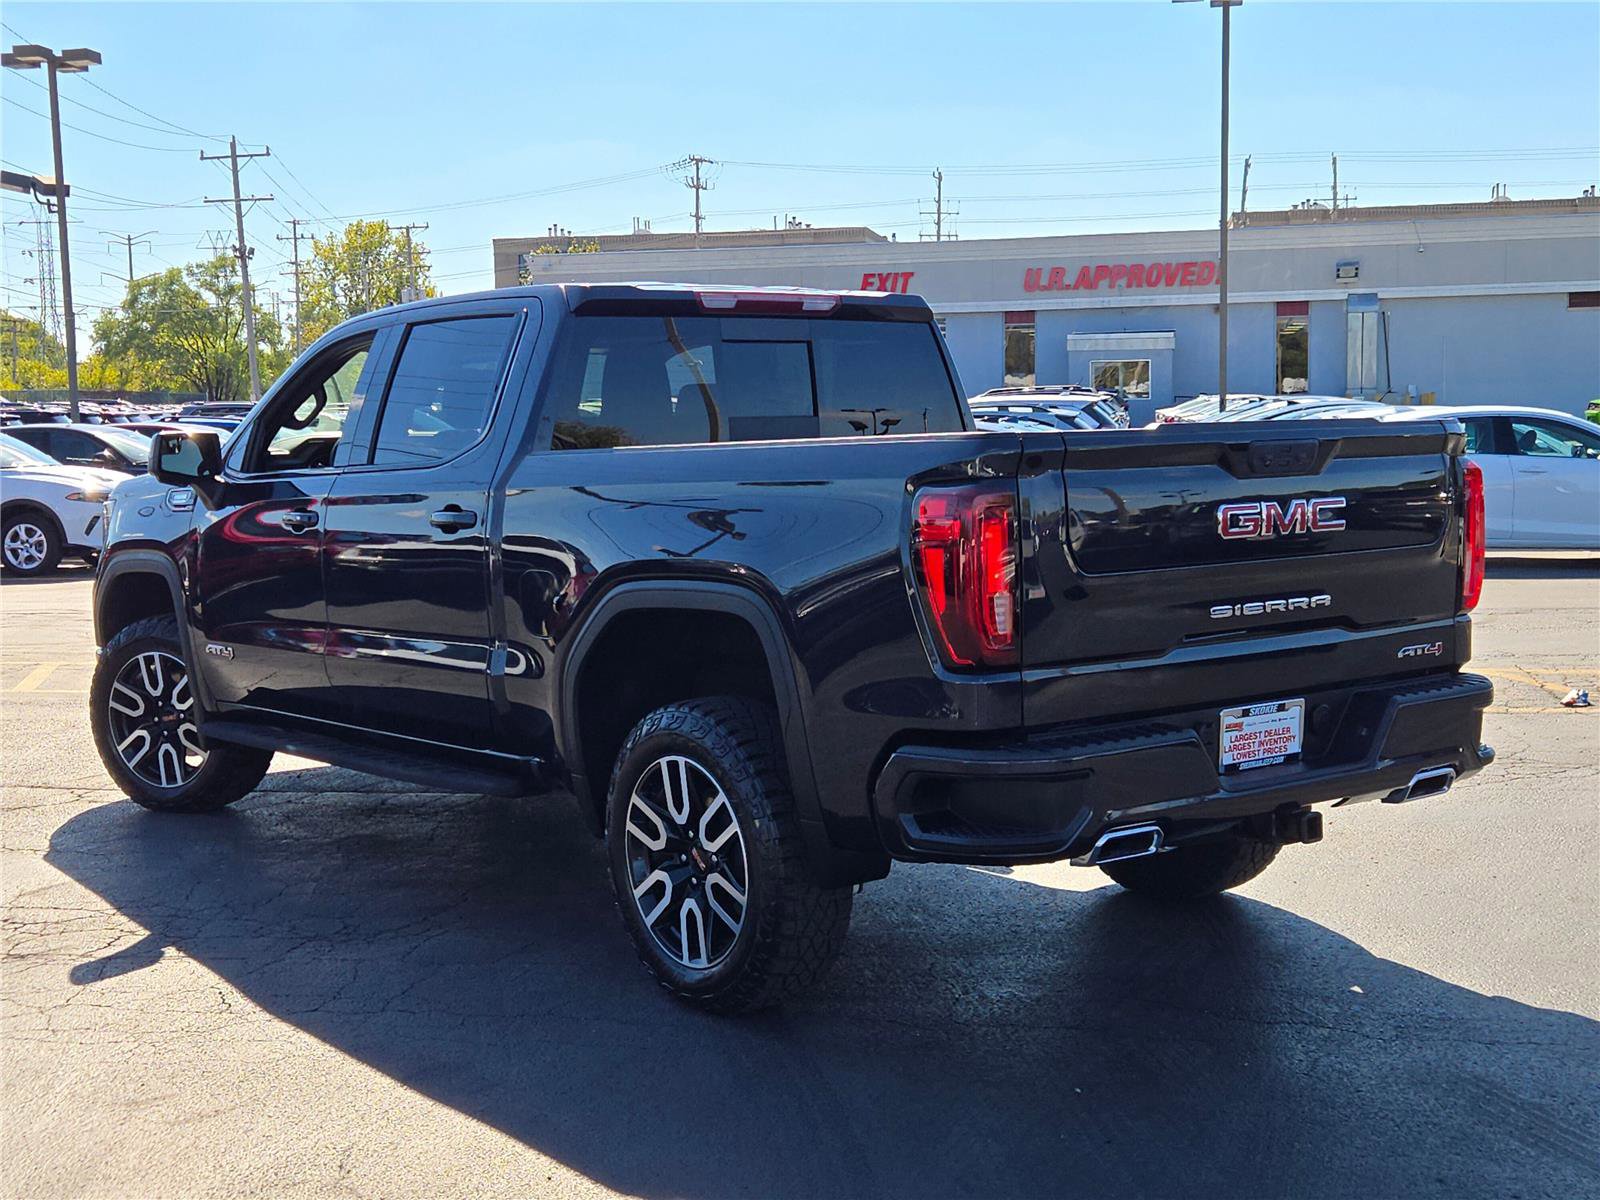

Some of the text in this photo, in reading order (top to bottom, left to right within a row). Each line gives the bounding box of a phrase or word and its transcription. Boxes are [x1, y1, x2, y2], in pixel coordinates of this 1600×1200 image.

[860, 271, 914, 294] EXIT
[1217, 497, 1347, 540] GMC
[1209, 594, 1332, 619] SIERRA
[205, 643, 234, 661] AT4
[1397, 642, 1443, 659] AT4
[1249, 704, 1279, 716] SKOKIE
[1224, 735, 1296, 753] LARGEST INVENTORY
[1230, 727, 1291, 743] LARGEST DEALER
[1232, 745, 1288, 761] LOWEST PRICES
